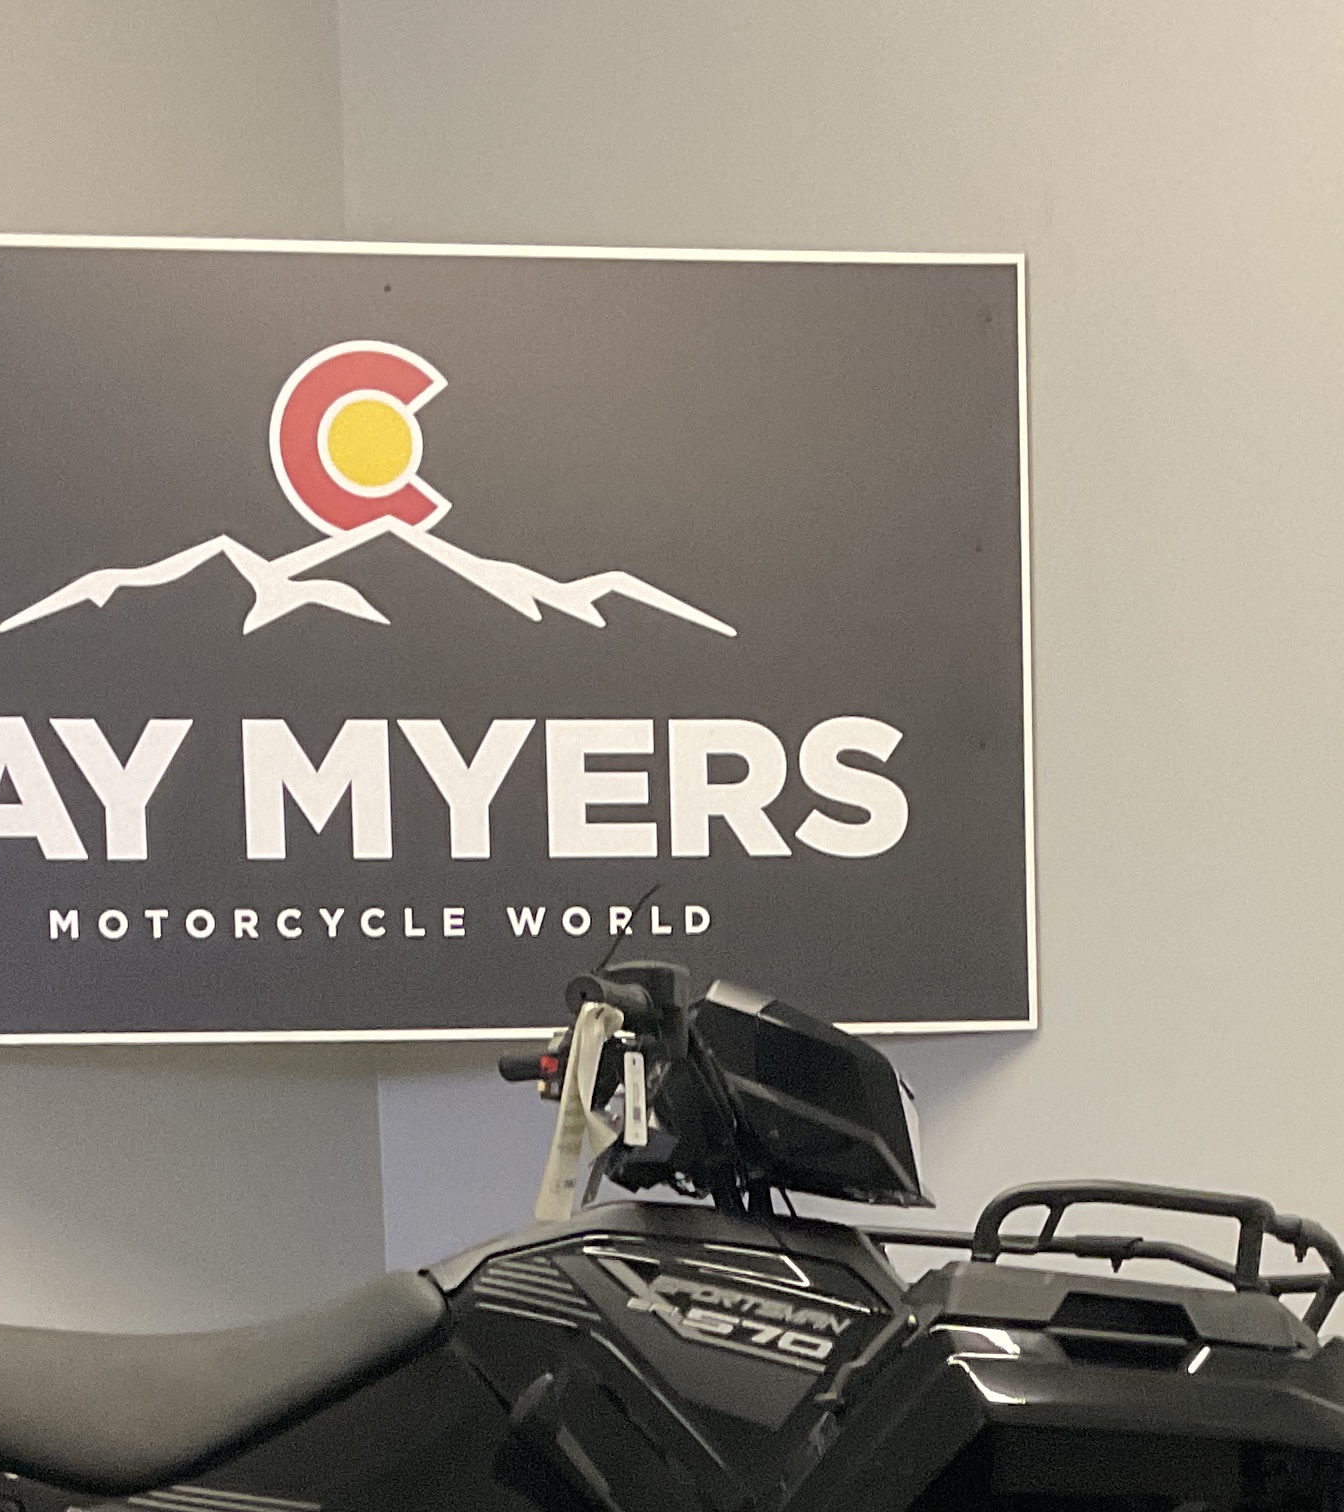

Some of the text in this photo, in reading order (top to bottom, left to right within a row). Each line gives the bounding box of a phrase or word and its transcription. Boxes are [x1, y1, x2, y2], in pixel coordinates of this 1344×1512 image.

[241, 716, 909, 860] MYERS
[49, 905, 711, 940] MOTORCYCLE WORLD
[682, 1306, 833, 1360] 570
